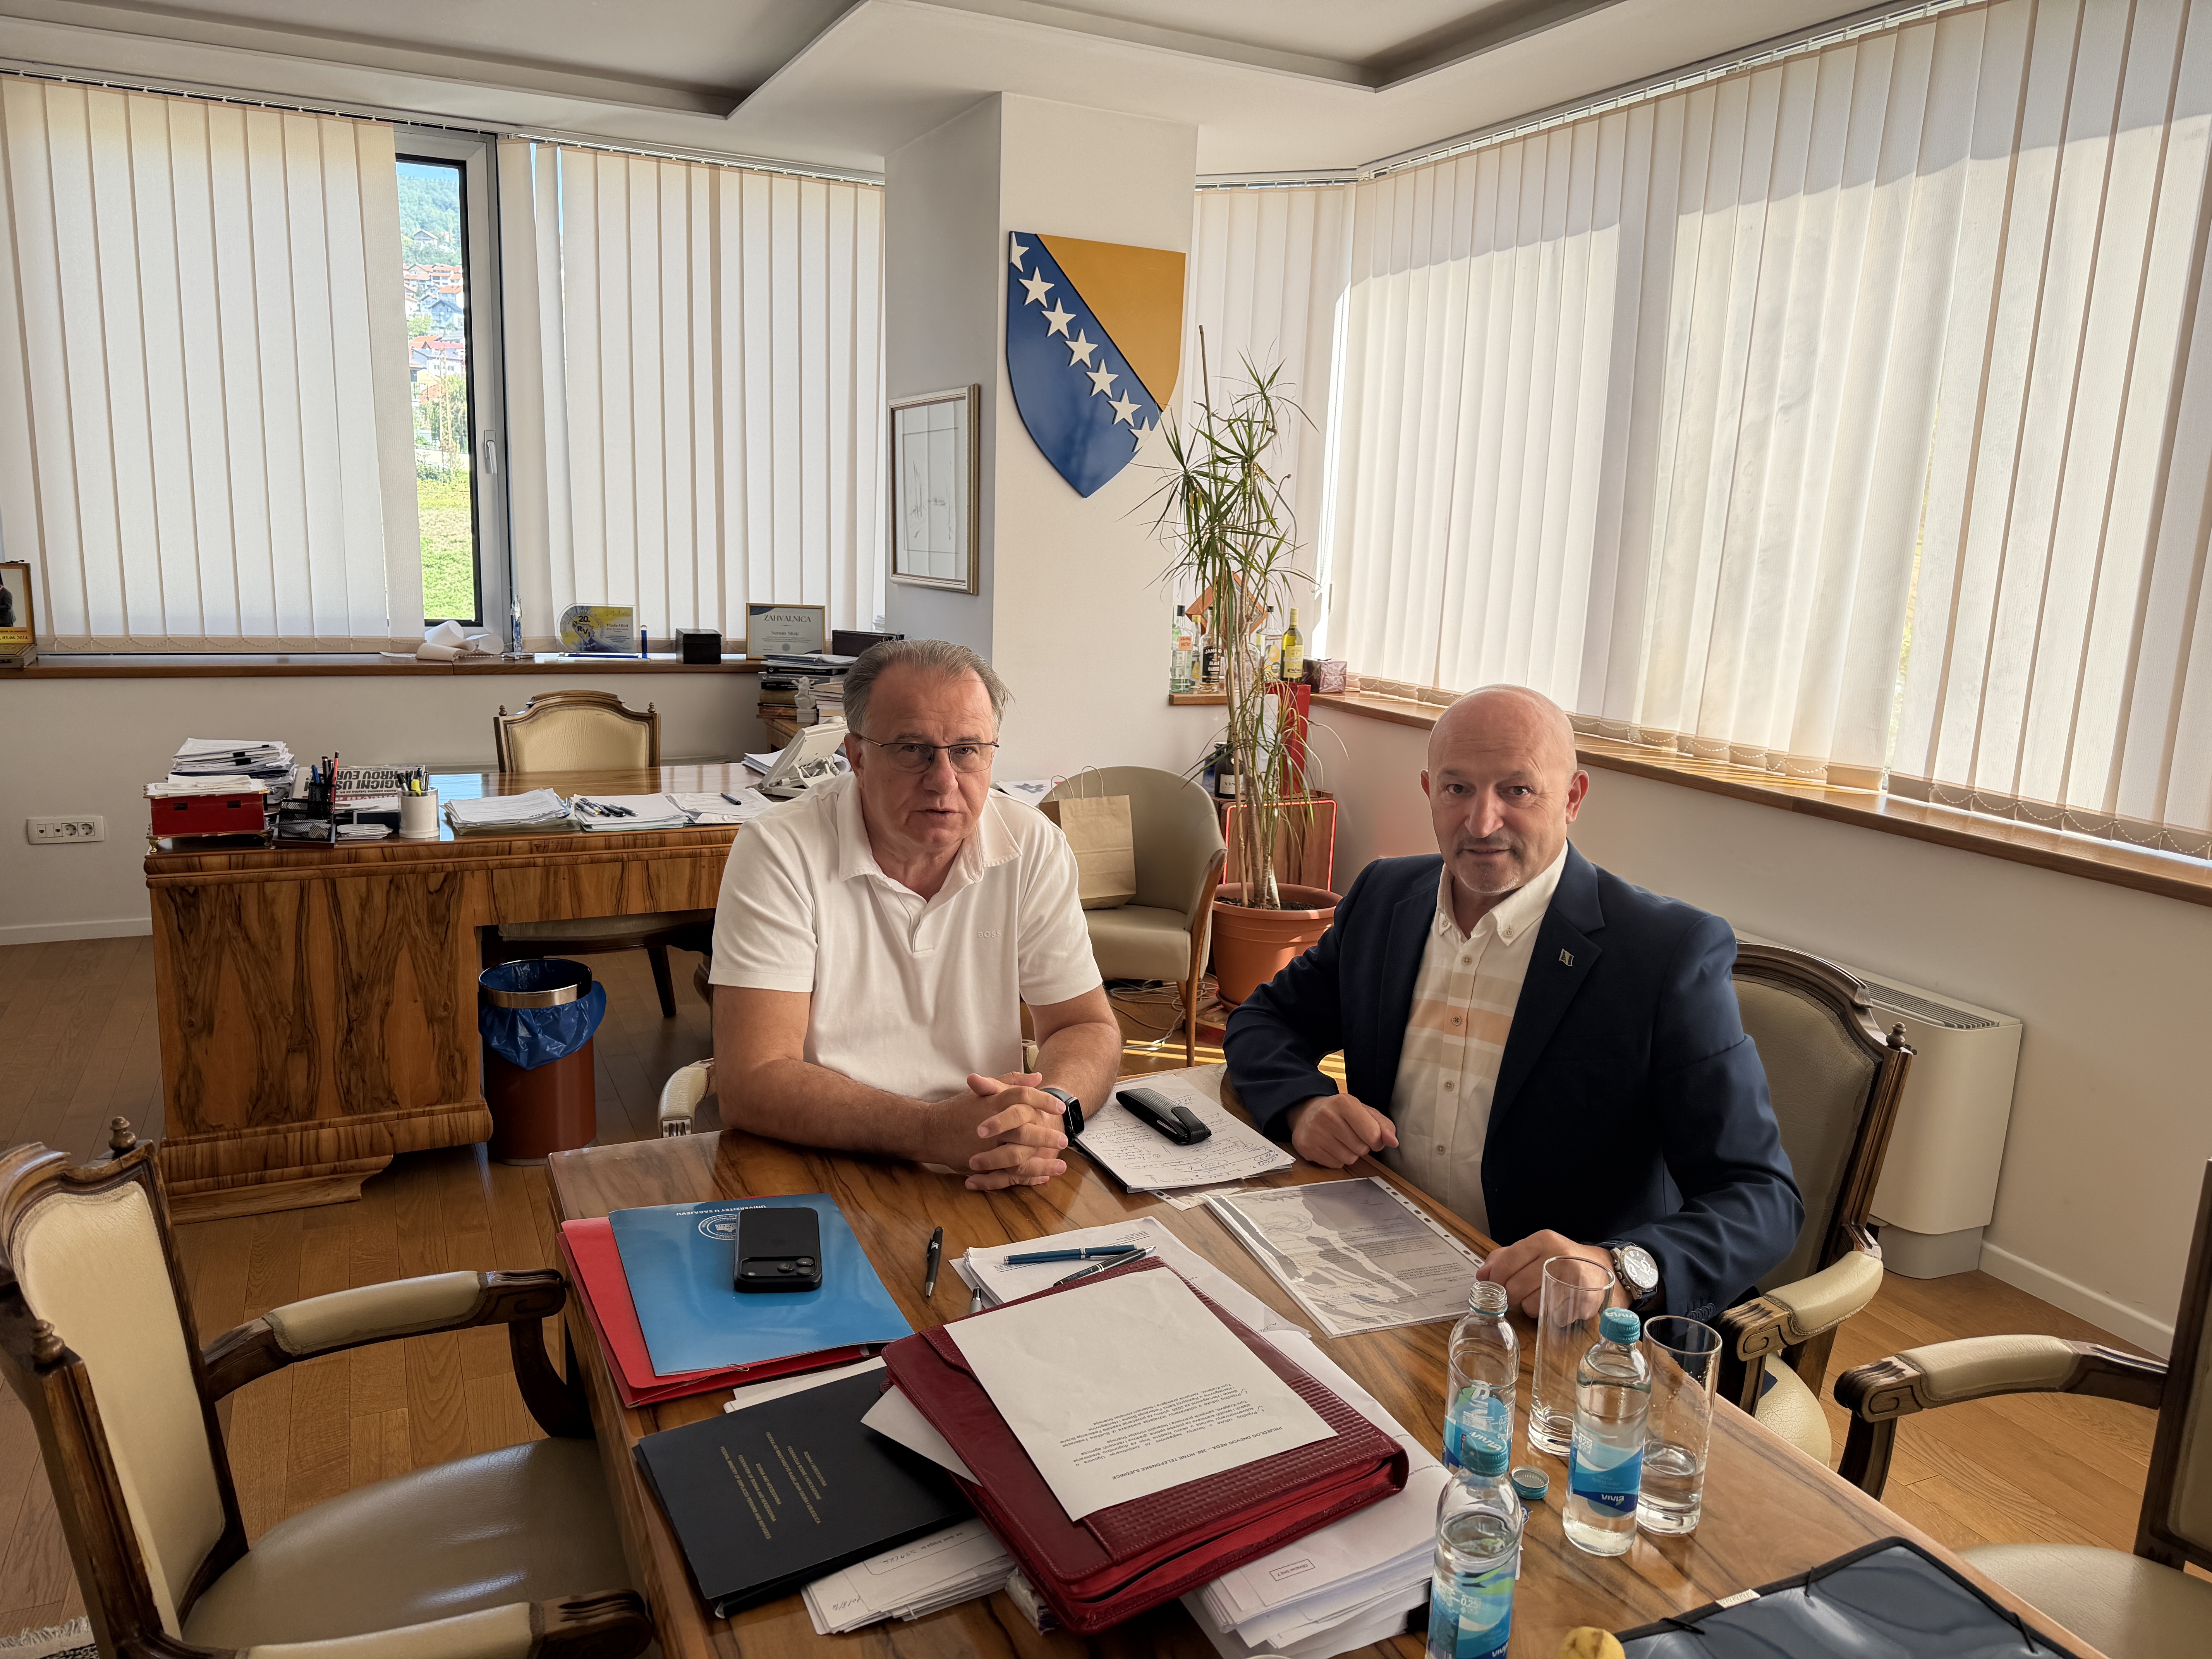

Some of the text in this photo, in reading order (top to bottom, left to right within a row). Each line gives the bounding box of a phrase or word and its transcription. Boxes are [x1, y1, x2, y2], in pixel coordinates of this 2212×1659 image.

[764, 614, 812, 623] ZAHVALNICA
[356, 780, 398, 791] AGIČNI
[1251, 1426, 1282, 1437] PRIJEDLOG
[1228, 1435, 1252, 1445] DNEVOG
[1140, 1458, 1178, 1471] TELEFONSKE
[1111, 1468, 1140, 1480] SJEDNICE
